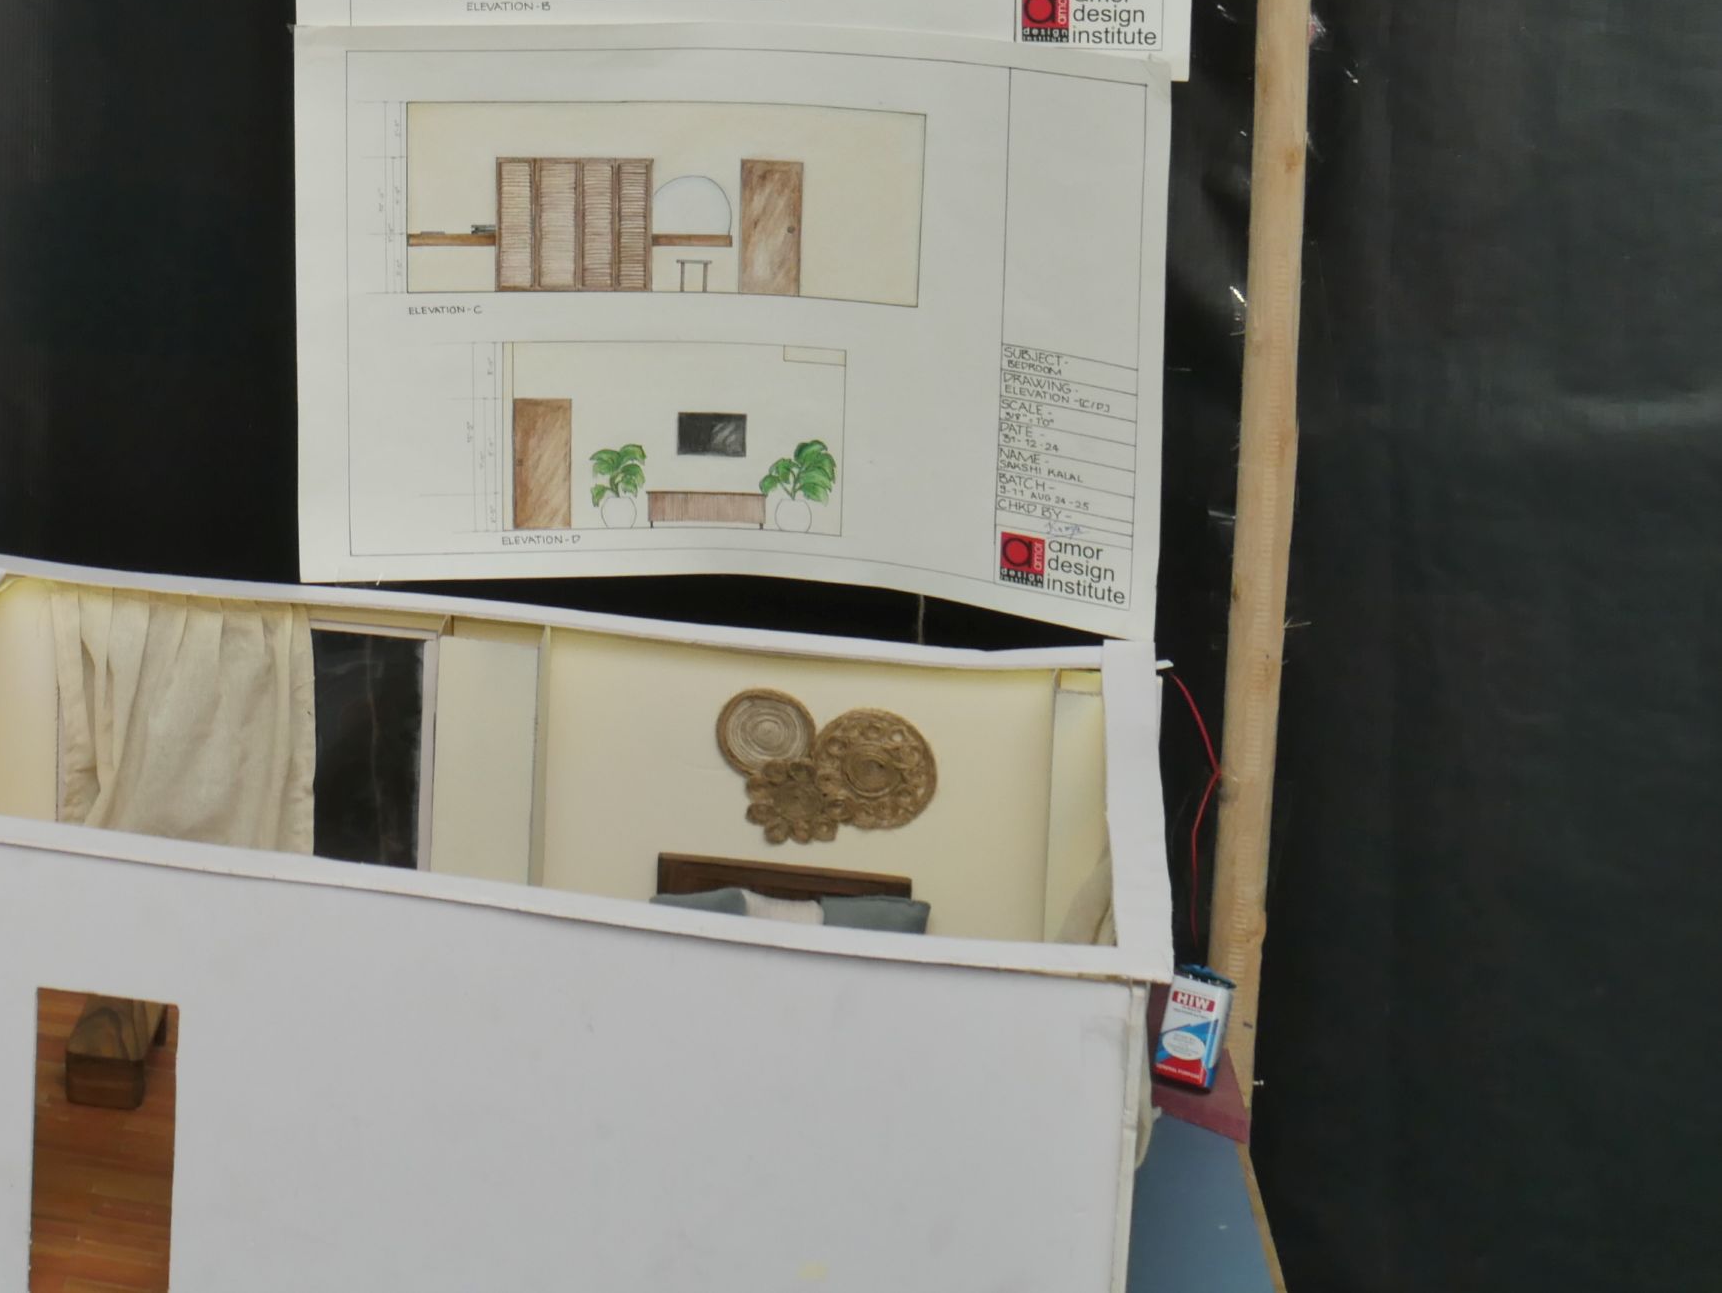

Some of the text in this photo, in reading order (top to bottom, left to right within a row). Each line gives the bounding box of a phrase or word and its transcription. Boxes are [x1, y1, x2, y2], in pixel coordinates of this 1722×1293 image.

[1073, 4, 1145, 28] design
[1073, 25, 1157, 45] institute
[998, 498, 1036, 514] CHKD
[1048, 539, 1104, 561] amor
[1047, 555, 1115, 583] design
[1047, 573, 1126, 605] institute
